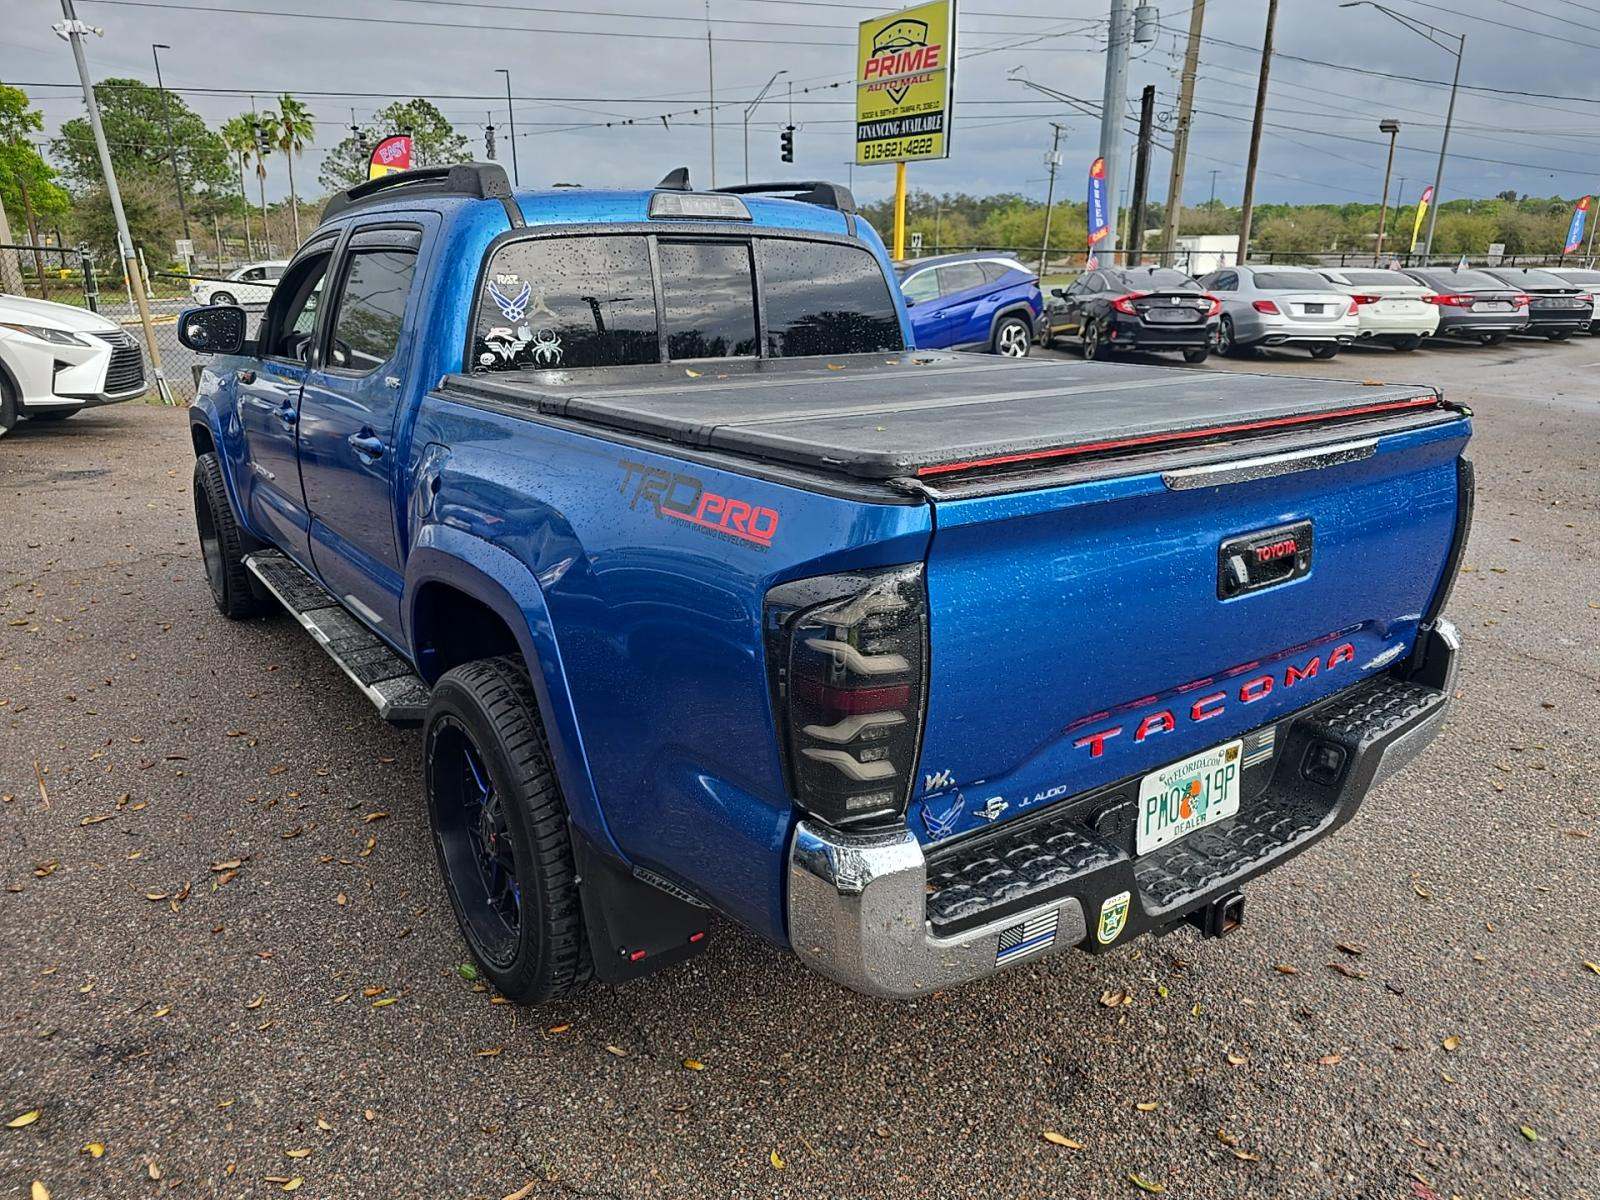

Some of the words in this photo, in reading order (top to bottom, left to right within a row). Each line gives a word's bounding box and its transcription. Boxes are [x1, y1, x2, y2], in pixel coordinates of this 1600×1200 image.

[864, 44, 942, 81] PRIME
[867, 81, 898, 92] AUTO
[900, 75, 934, 87] MALL
[858, 122, 900, 139] FINANCING
[899, 115, 943, 134] AVAILABLE
[379, 139, 408, 164] EASY
[864, 138, 932, 159] 813-621-4222
[618, 459, 703, 519] TRD
[696, 491, 780, 541] PRO
[667, 516, 691, 530] TOYOTA
[691, 522, 718, 539] RACING
[717, 529, 771, 554] DEVELOPMENT
[1256, 539, 1297, 561] TOYOTA
[1073, 641, 1356, 759] TACOMA
[1018, 797, 1032, 808] JL
[1033, 784, 1068, 802] AUDIO
[1174, 813, 1207, 836] DEALER
